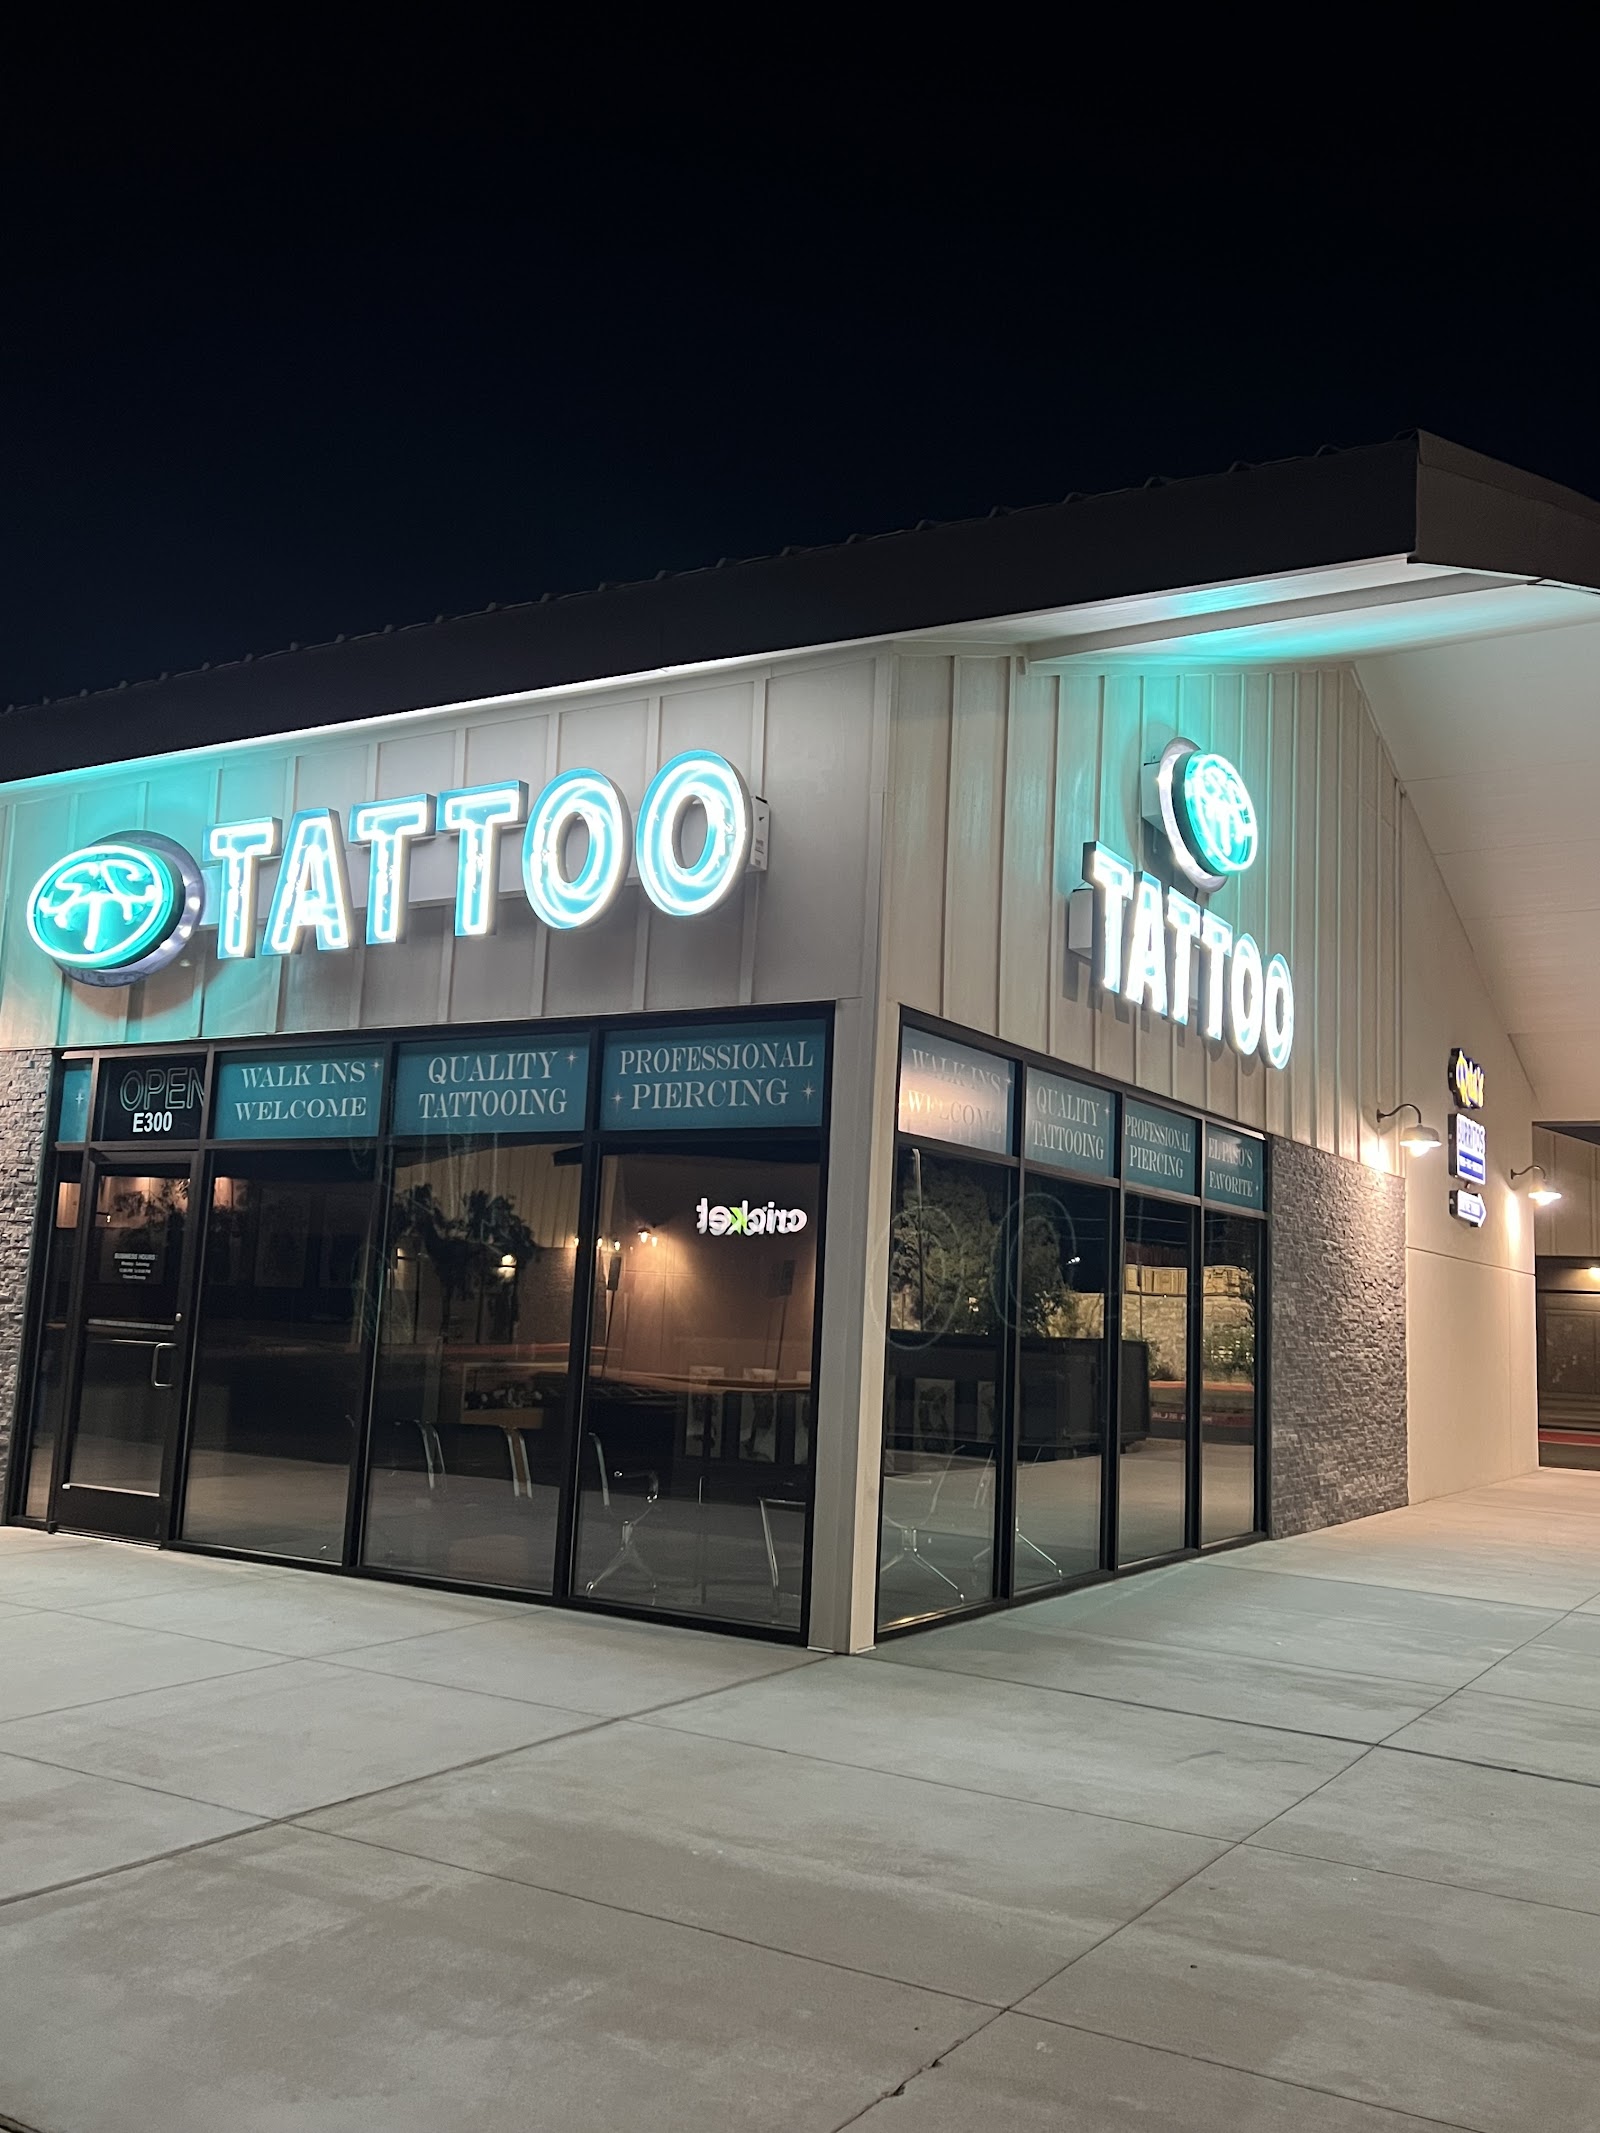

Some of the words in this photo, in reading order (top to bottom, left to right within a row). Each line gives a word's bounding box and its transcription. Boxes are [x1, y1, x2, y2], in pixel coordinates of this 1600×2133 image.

[203, 749, 749, 959] TATTOO
[1086, 841, 1294, 1069] TATTOO
[241, 1064, 311, 1088] WALK
[320, 1061, 366, 1084] INS
[428, 1051, 559, 1084] QUALITY
[618, 1041, 814, 1076] PROFESSIONAL
[912, 1048, 966, 1088] WALK
[970, 1066, 1001, 1097] INS
[120, 1067, 205, 1111] OPEN
[419, 1088, 567, 1119] TATTOOING
[631, 1078, 788, 1110] PIERCING
[132, 1111, 173, 1133] E300
[235, 1097, 367, 1121] WELCOME
[1035, 1086, 1100, 1127] QUALITY
[1031, 1120, 1104, 1160] TATTOOING
[1125, 1114, 1191, 1153] PROFESSIONAL
[1129, 1148, 1184, 1179] PIERCING
[1209, 1138, 1221, 1159] EL
[1222, 1143, 1253, 1169] PASO'S
[1209, 1170, 1253, 1198] FAVORITE
